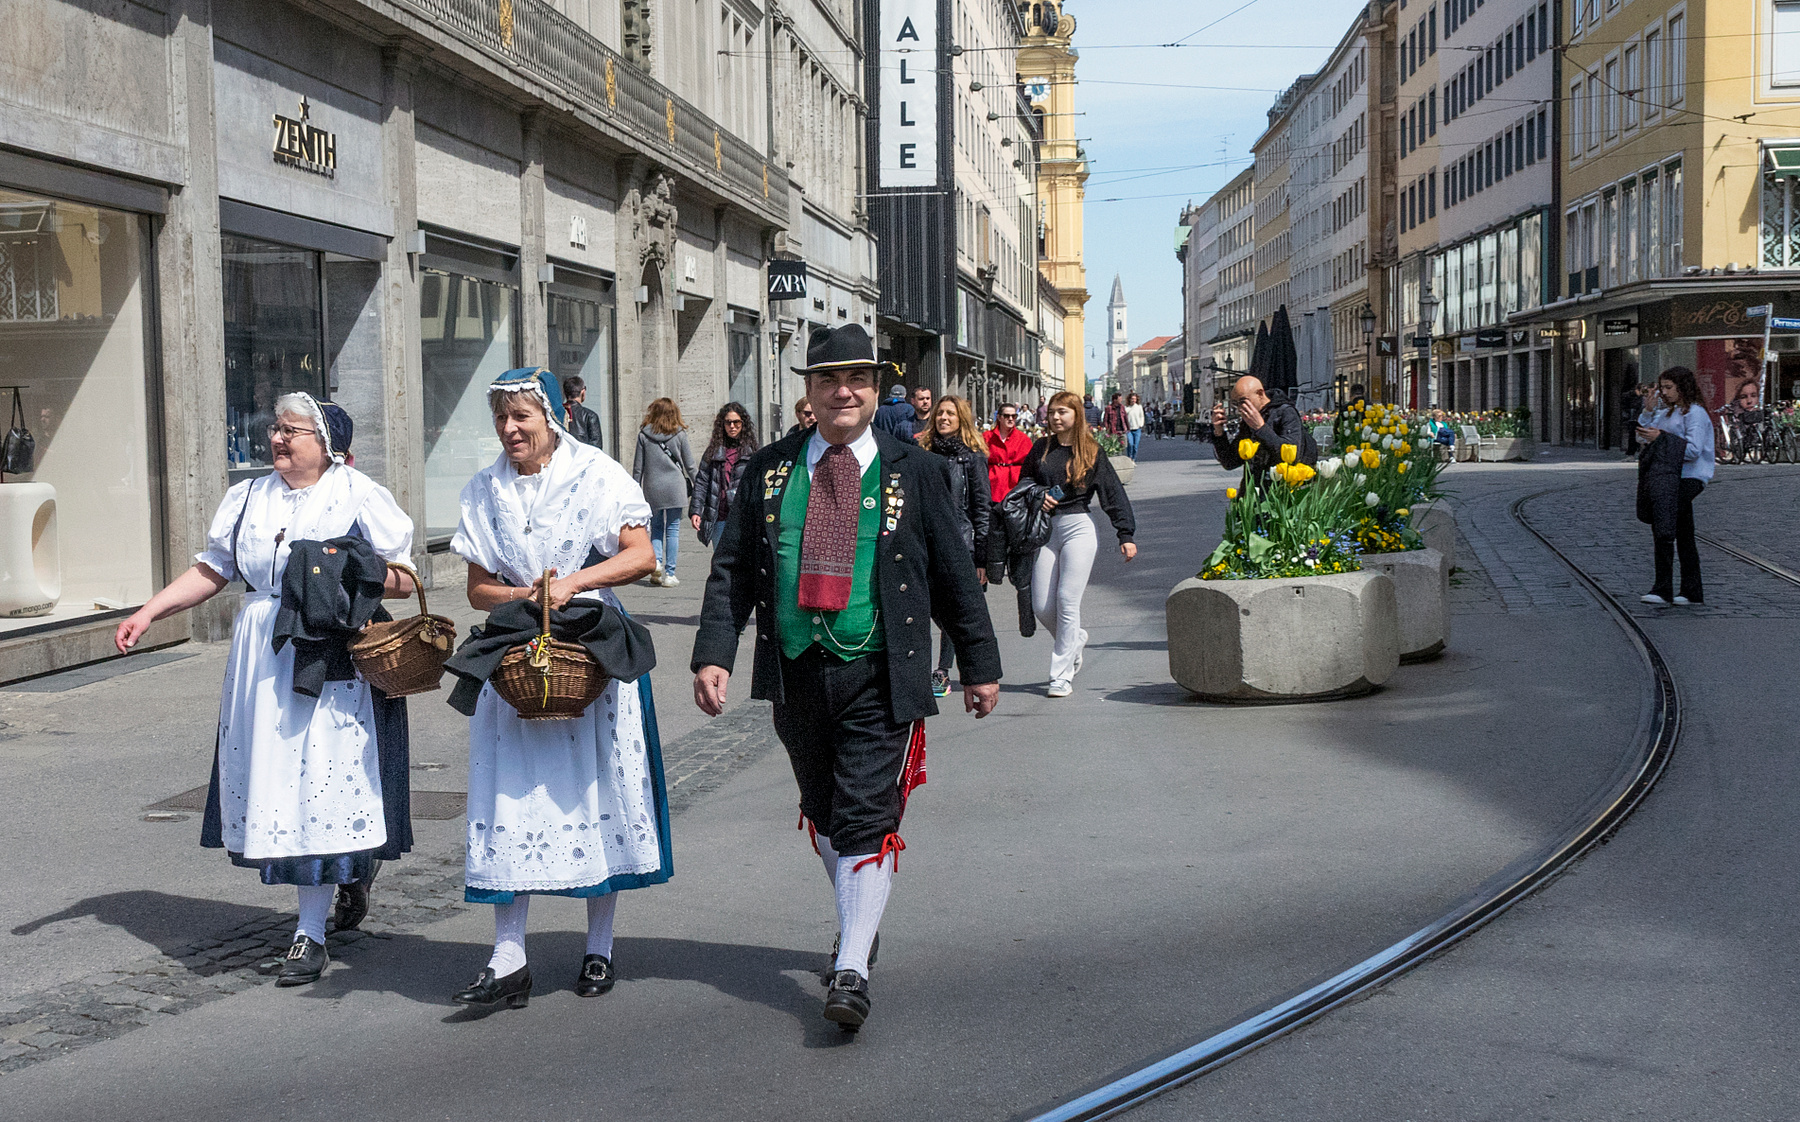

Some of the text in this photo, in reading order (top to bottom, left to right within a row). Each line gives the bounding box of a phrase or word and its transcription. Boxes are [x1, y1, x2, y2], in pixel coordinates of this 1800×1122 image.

[896, 16, 920, 169] ALLE
[272, 113, 337, 170] ZENITH
[769, 274, 806, 293] ZARA
